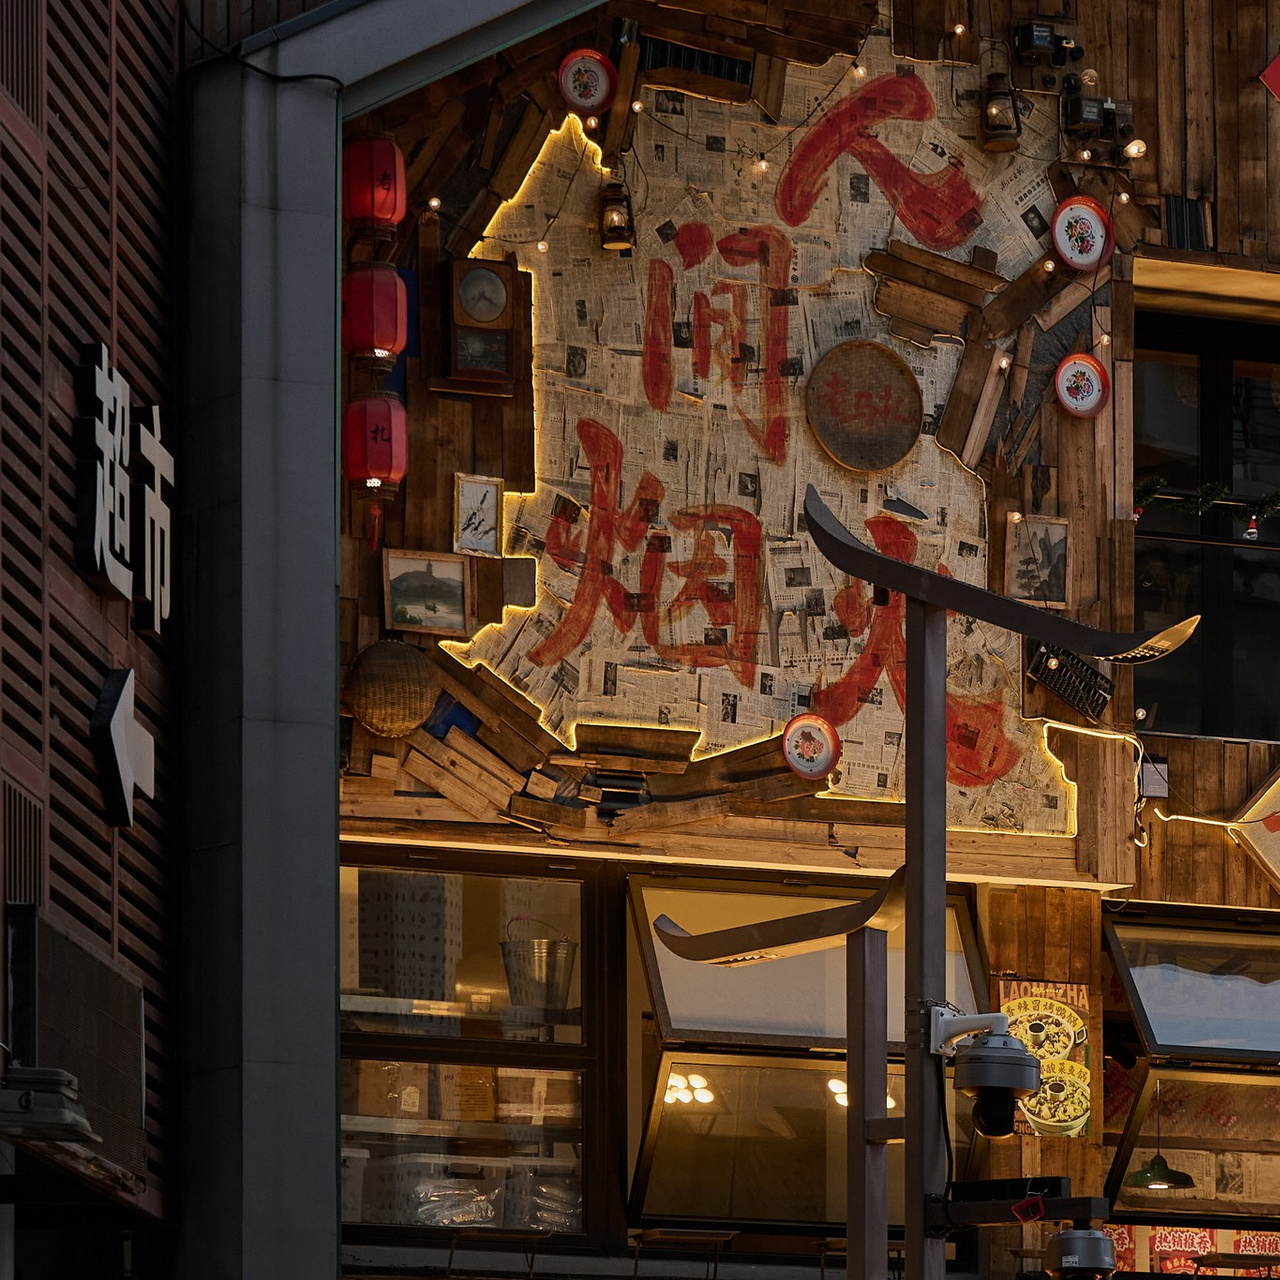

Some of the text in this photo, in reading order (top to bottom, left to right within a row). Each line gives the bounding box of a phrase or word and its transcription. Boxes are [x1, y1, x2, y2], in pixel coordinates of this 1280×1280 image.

[94, 342, 175, 634] 超市
[1155, 1230, 1211, 1255] 热销推荐
